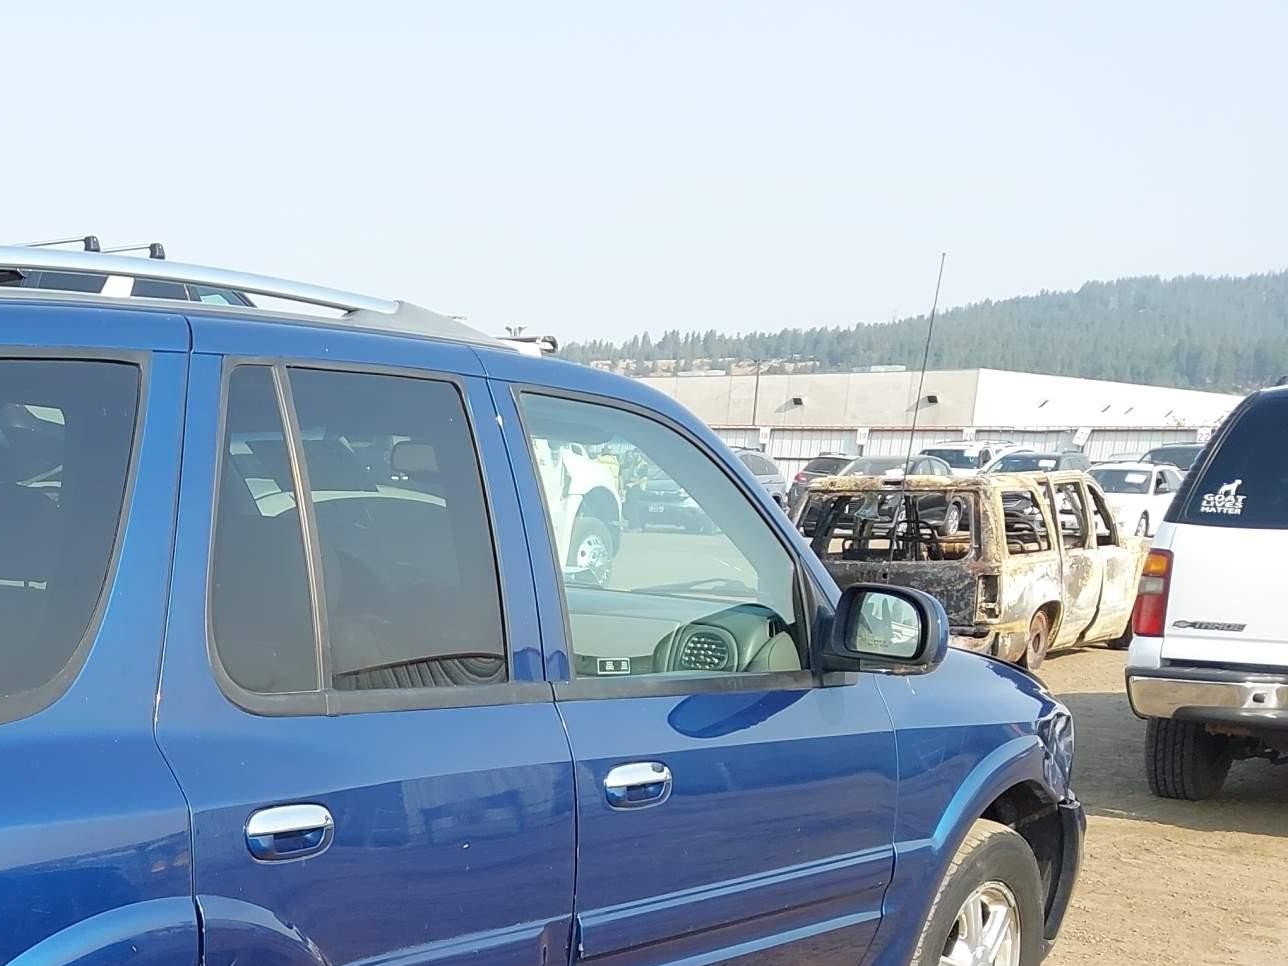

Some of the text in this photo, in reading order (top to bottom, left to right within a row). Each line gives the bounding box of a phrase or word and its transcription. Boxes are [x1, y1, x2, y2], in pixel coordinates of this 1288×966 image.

[1203, 493, 1247, 503] GOAT
[1201, 500, 1244, 509] LIVES
[1200, 506, 1241, 515] MATTER
